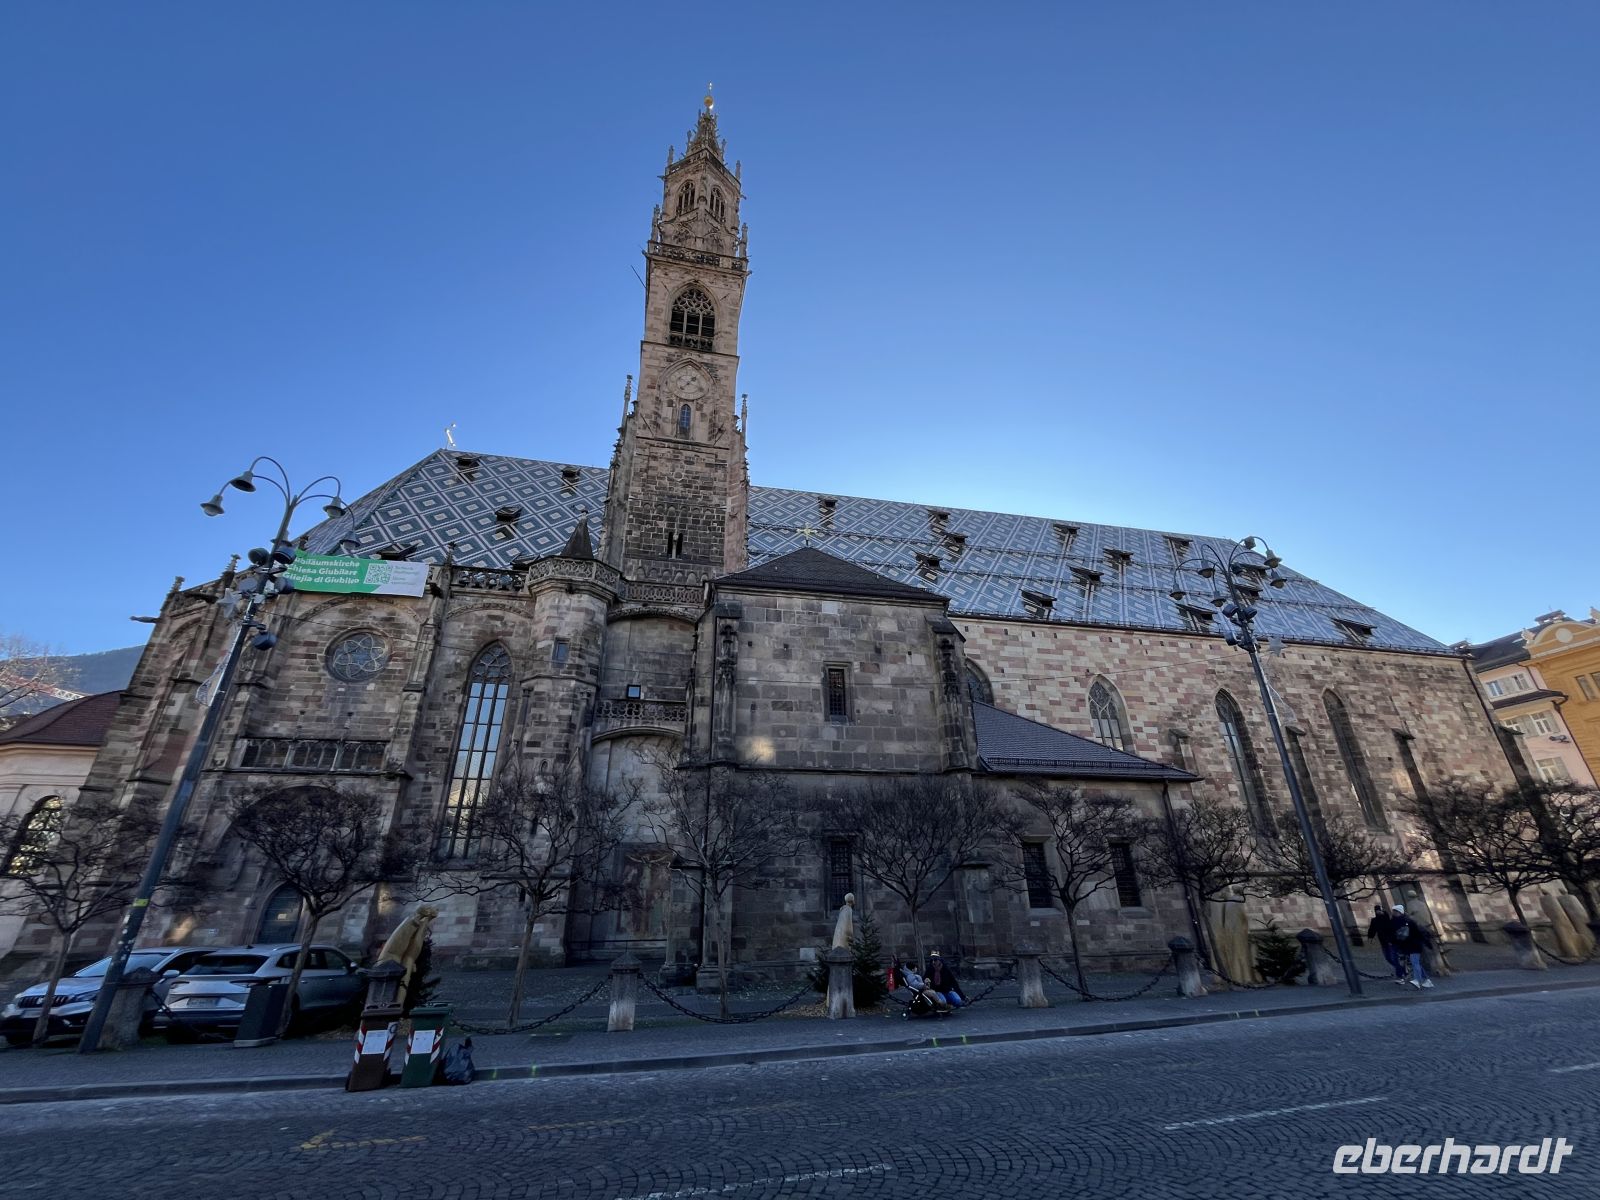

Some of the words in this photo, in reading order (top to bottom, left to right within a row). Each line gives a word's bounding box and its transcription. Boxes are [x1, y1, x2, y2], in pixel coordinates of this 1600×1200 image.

[294, 556, 361, 568] ubiläumskirche
[318, 567, 358, 576] Giubilare
[313, 576, 323, 584] di
